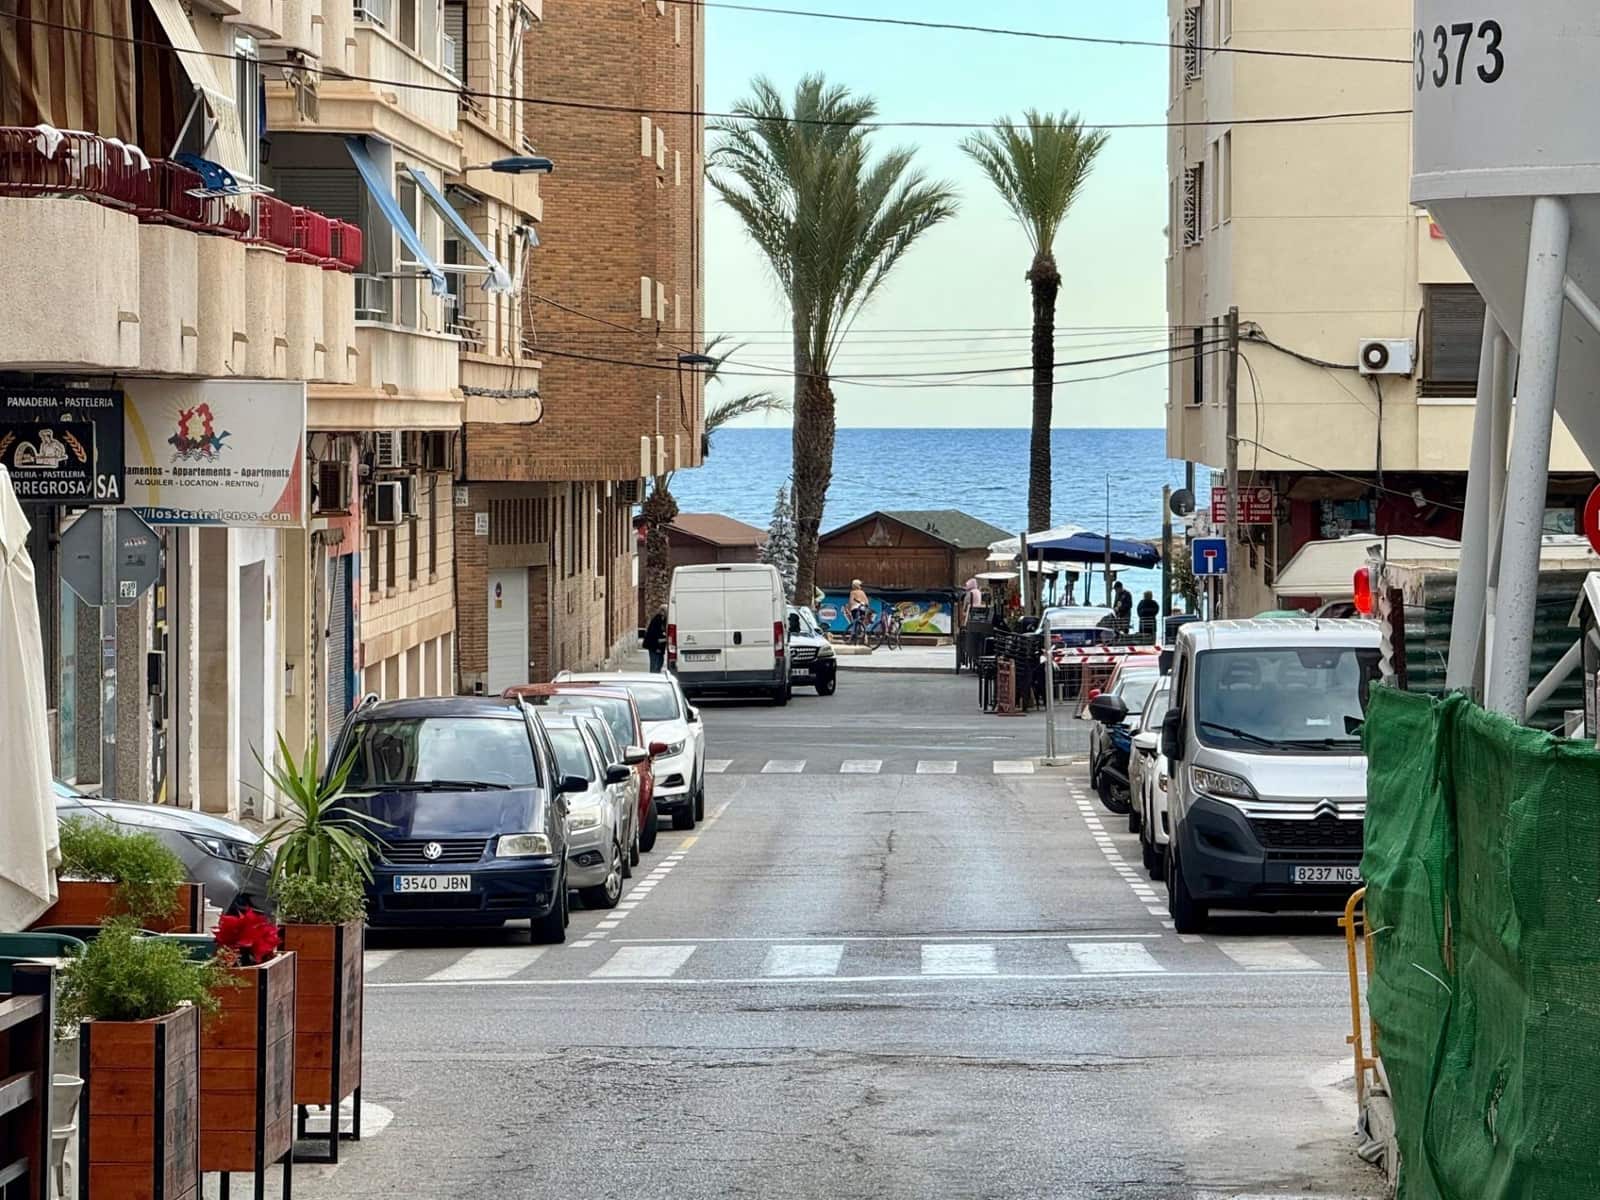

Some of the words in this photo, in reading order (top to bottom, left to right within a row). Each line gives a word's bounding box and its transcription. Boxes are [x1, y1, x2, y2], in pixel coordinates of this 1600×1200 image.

[1413, 29, 1425, 91] 3
[1432, 20, 1505, 88] 373
[7, 397, 58, 407] PANADERIA
[64, 397, 114, 407] PASTELERIA
[43, 470, 86, 478] PASTELERIA
[172, 466, 231, 477] Appartements
[241, 467, 290, 477] Apartments
[180, 479, 219, 487] LOCATION
[1298, 868, 1331, 880] 8237
[403, 877, 437, 890] 3540
[443, 877, 468, 890] JBN
